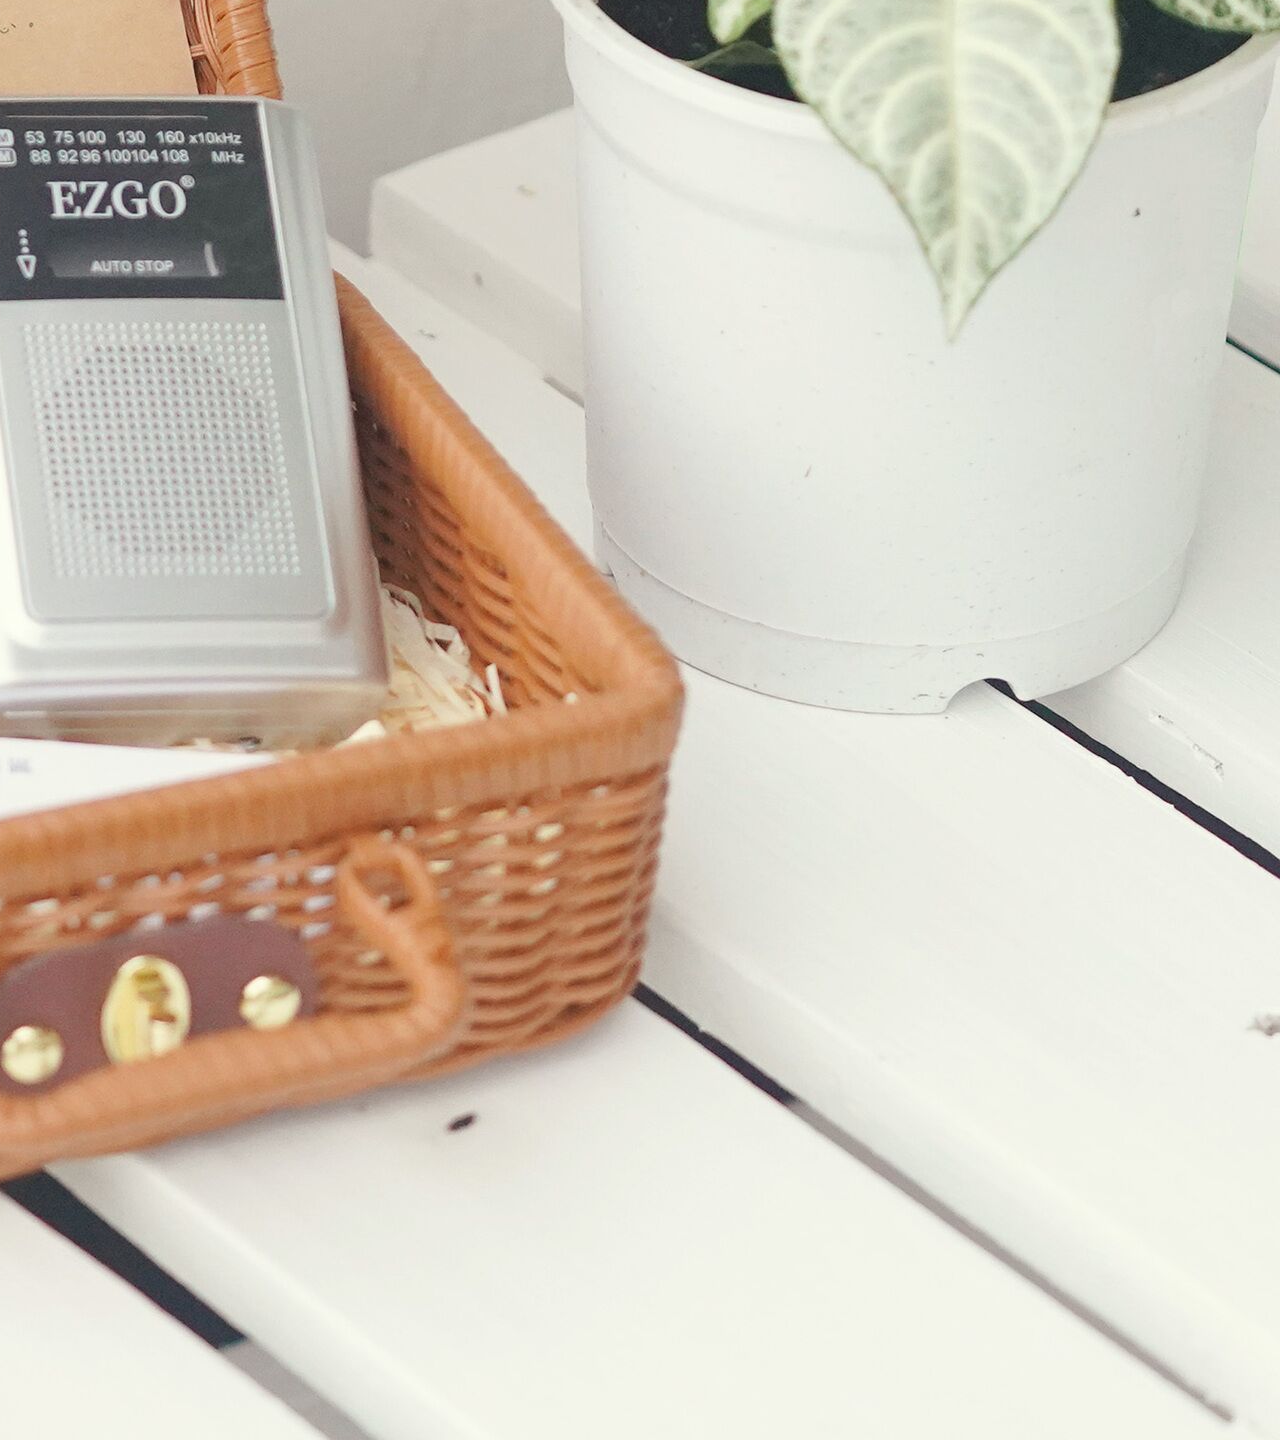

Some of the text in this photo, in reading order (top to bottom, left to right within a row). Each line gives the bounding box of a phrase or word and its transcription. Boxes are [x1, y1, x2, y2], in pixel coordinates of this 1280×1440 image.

[25, 131, 45, 144] 53
[54, 131, 74, 144] 75
[78, 131, 106, 144] 100
[117, 131, 146, 144] 130
[156, 131, 185, 144] 160
[189, 131, 242, 145] x10kHz
[30, 150, 51, 163] 88
[58, 150, 78, 163] 92
[81, 150, 101, 163] 96
[103, 150, 131, 163] 100
[131, 150, 159, 163] 104
[161, 150, 190, 163] 108
[211, 150, 245, 163] MHz
[90, 261, 175, 273] AUTO STOP
